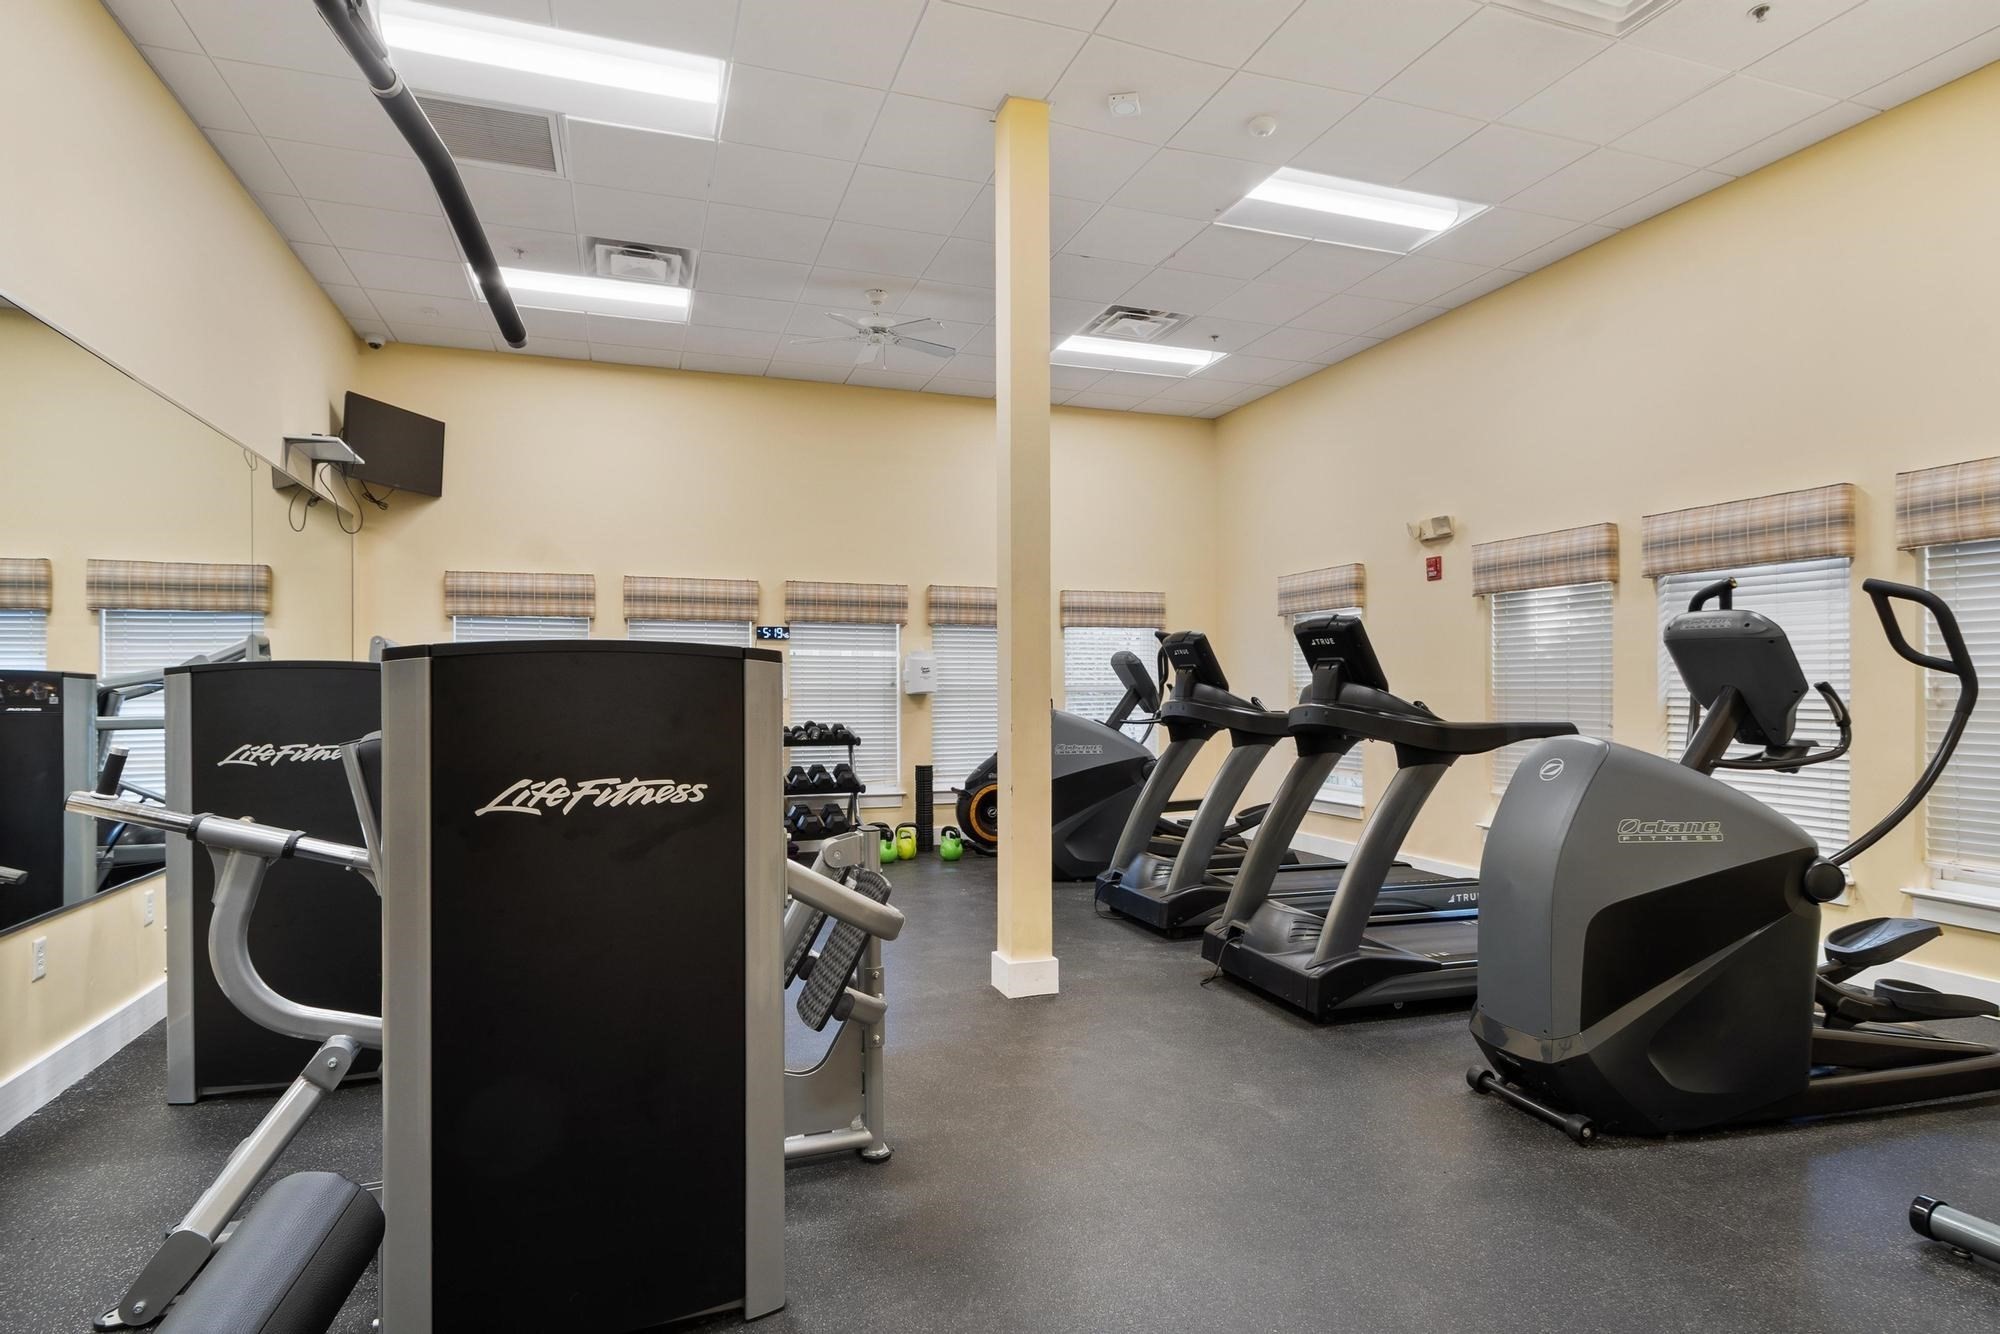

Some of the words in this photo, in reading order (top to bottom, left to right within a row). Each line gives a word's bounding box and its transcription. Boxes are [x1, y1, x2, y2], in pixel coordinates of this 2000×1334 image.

[763, 627, 783, 639] 5:19
[1315, 637, 1336, 645] TRUE
[270, 744, 342, 767] Fitne
[475, 778, 571, 816] Life
[563, 777, 708, 816] Fitness
[1618, 819, 1721, 833] Octane
[1456, 893, 1479, 902] TRU
